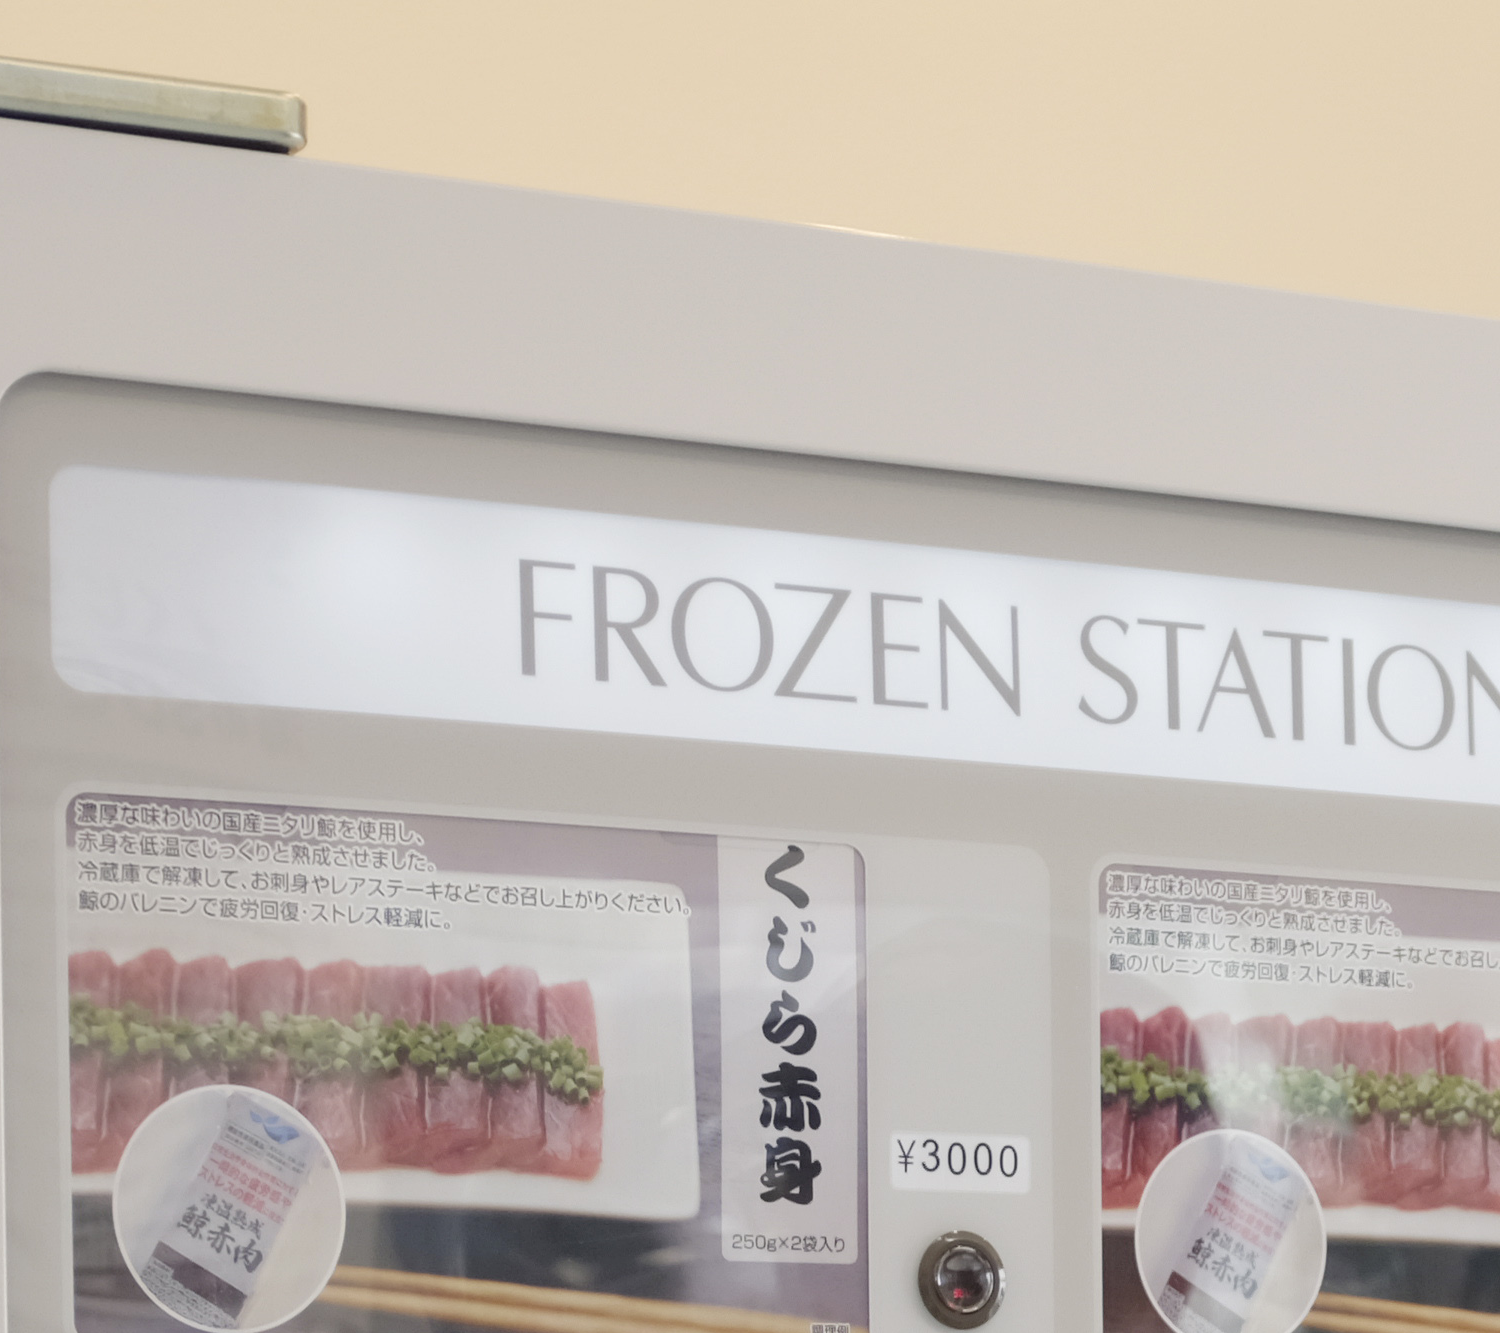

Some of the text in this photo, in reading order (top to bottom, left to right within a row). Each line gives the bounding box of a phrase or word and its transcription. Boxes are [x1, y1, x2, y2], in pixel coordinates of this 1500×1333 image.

[517, 558, 1021, 716] FROZEN
[758, 844, 822, 1205] くじら赤身
[896, 1138, 1019, 1178] ¥3000
